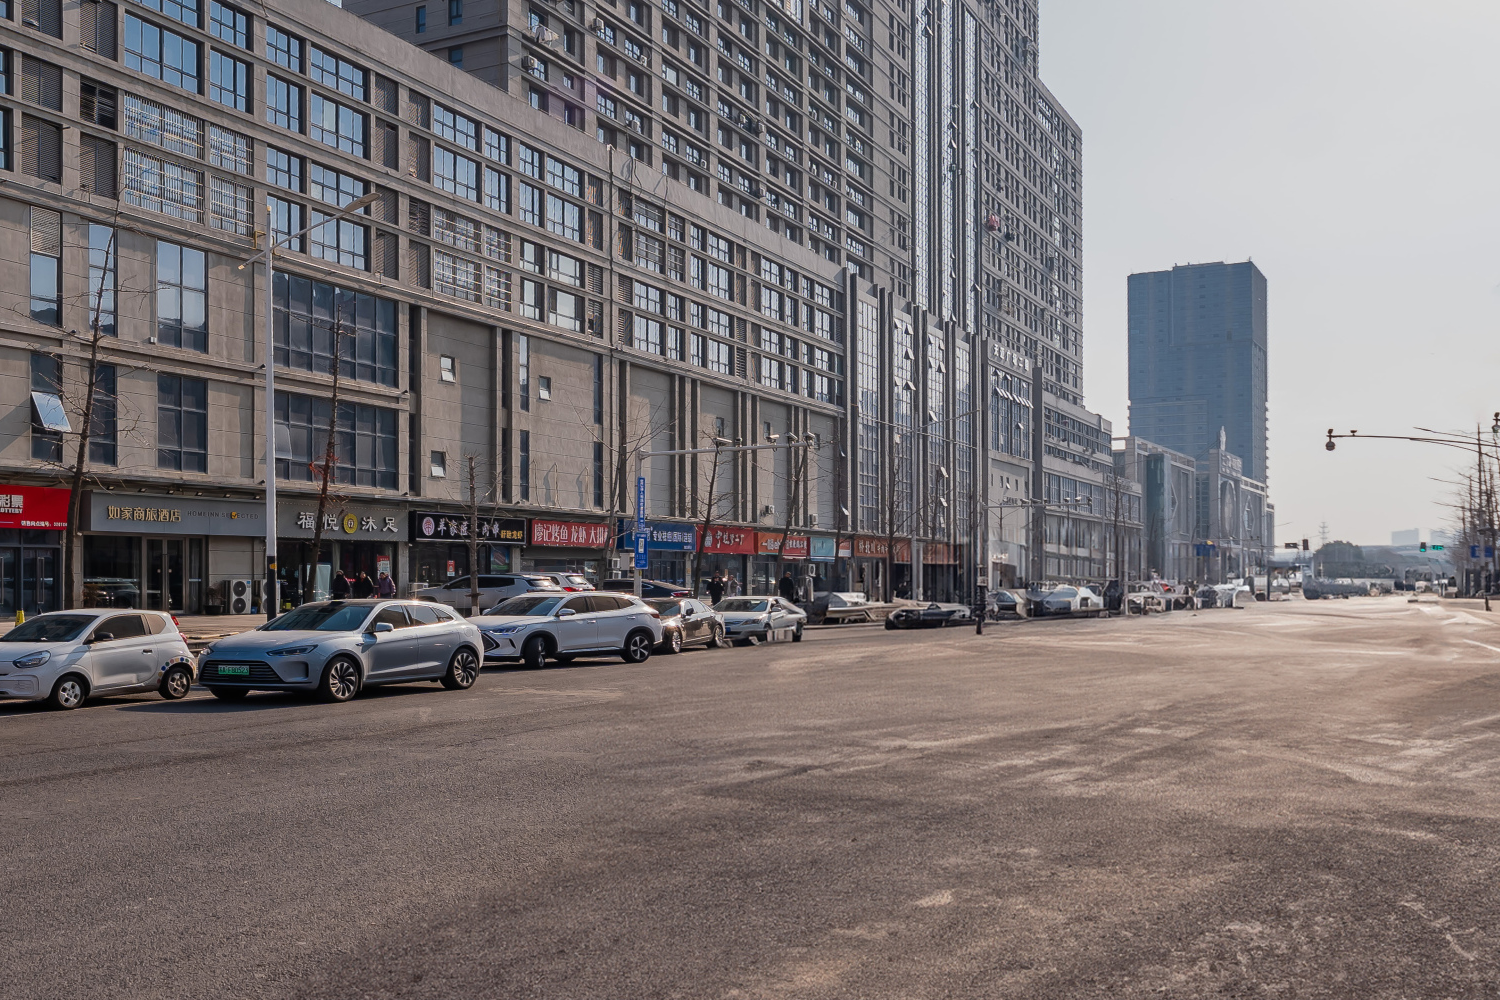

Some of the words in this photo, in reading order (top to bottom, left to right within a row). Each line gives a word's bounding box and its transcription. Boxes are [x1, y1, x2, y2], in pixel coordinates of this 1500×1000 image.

[107, 504, 182, 523] 如家商旅酒店
